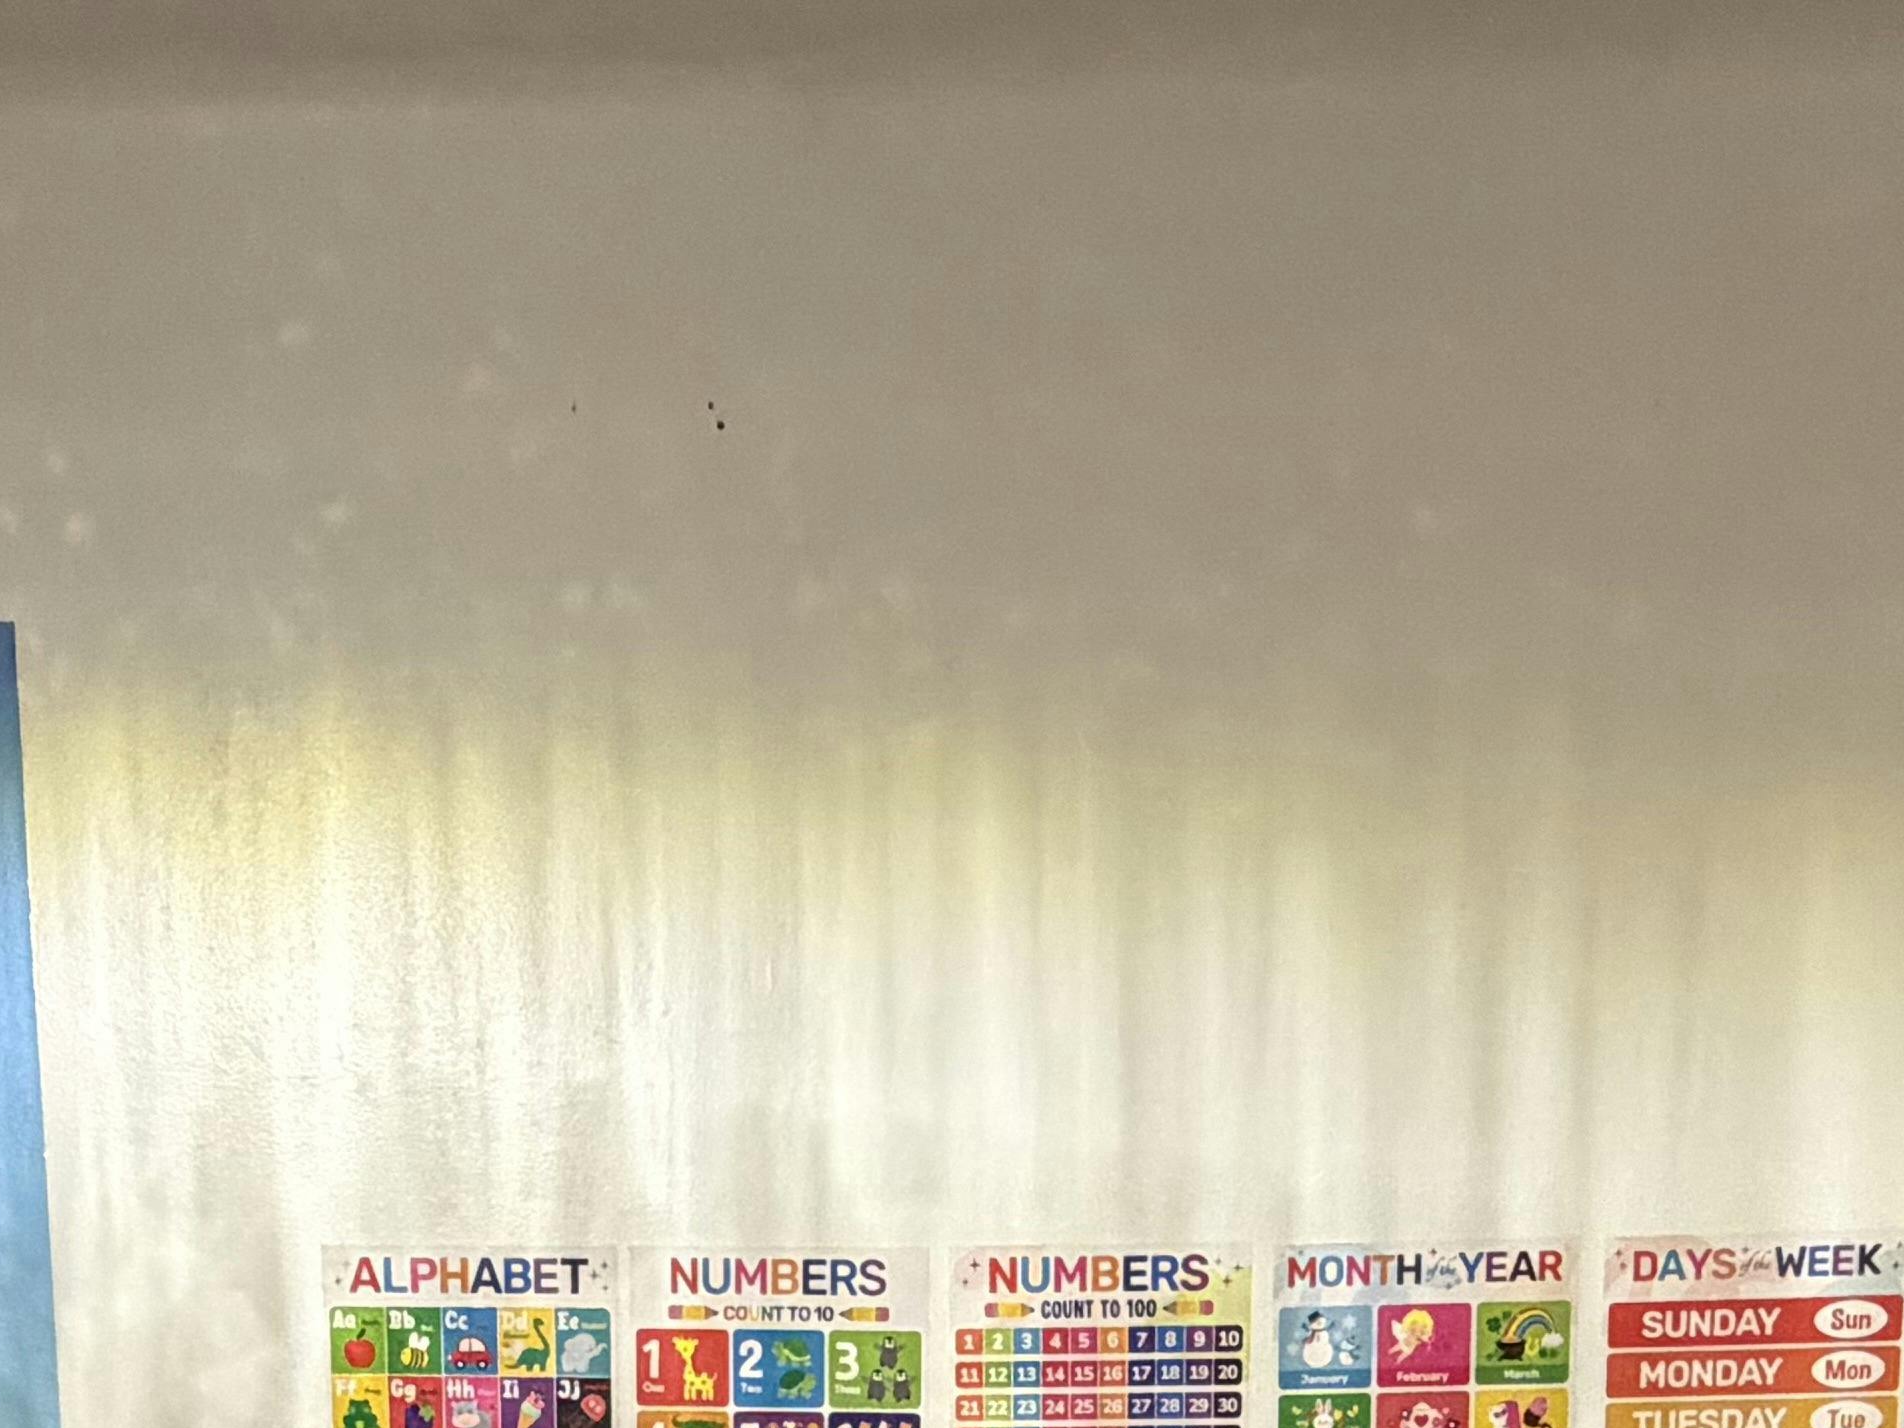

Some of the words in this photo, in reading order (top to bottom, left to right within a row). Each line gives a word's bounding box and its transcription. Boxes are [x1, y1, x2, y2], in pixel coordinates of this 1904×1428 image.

[349, 1256, 589, 1294] ALPHABET
[670, 1258, 887, 1296] NUMBERS
[988, 1254, 1210, 1293] NUMBERS
[1287, 1253, 1422, 1288] MONTH
[1458, 1250, 1563, 1282] YEAR
[1632, 1248, 1736, 1282] DAYS
[1776, 1243, 1883, 1277] WEEK
[723, 1306, 784, 1321] COUNT
[784, 1306, 810, 1322] TO
[815, 1306, 833, 1322] 10
[1041, 1300, 1096, 1318] COUNT
[1101, 1300, 1121, 1318] TO
[1127, 1299, 1156, 1318] 100
[1641, 1308, 1781, 1338] SUNDAY
[1830, 1309, 1872, 1330] Sun
[642, 1339, 660, 1378] 1
[738, 1339, 764, 1378] 2
[834, 1341, 859, 1381] 3
[1503, 1369, 1540, 1379] March
[1639, 1358, 1783, 1389] MONDAY
[1825, 1360, 1872, 1381] Mon
[1300, 1373, 1349, 1385] January
[1396, 1371, 1449, 1383] February
[1827, 1410, 1865, 1428] Tue
